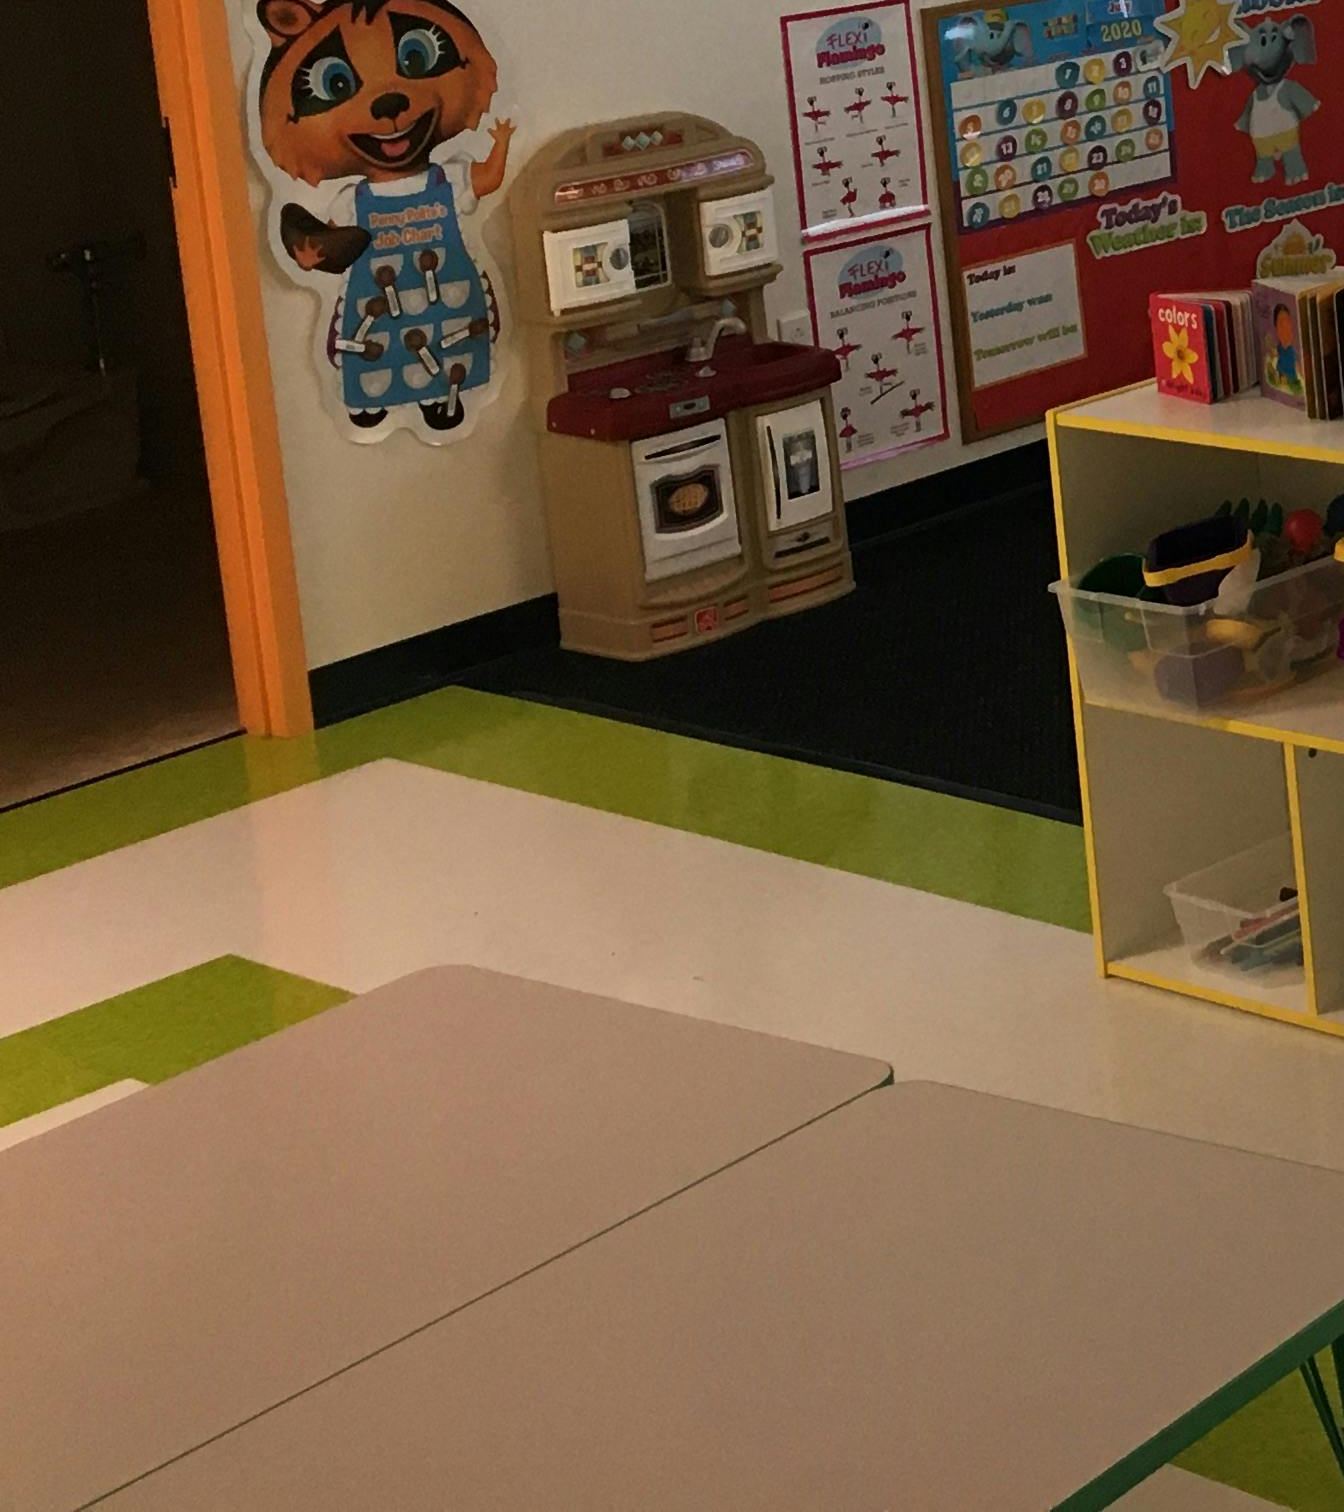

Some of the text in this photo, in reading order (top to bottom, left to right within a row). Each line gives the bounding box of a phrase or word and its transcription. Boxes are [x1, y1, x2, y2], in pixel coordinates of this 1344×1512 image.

[1109, 0, 1132, 15] Juy
[1101, 19, 1141, 42] 2020
[816, 42, 886, 68] Flamingo
[369, 201, 449, 228] Penny Polite's
[1101, 198, 1178, 230] Today's
[1225, 206, 1261, 229] The
[373, 223, 443, 250] Job Chart
[1089, 220, 1178, 254] Weather
[839, 270, 907, 299] Flamingo
[967, 267, 1001, 285] Today
[971, 299, 1025, 324] Yesterday
[1158, 305, 1198, 330] colors
[974, 337, 1036, 361] Tomorrow
